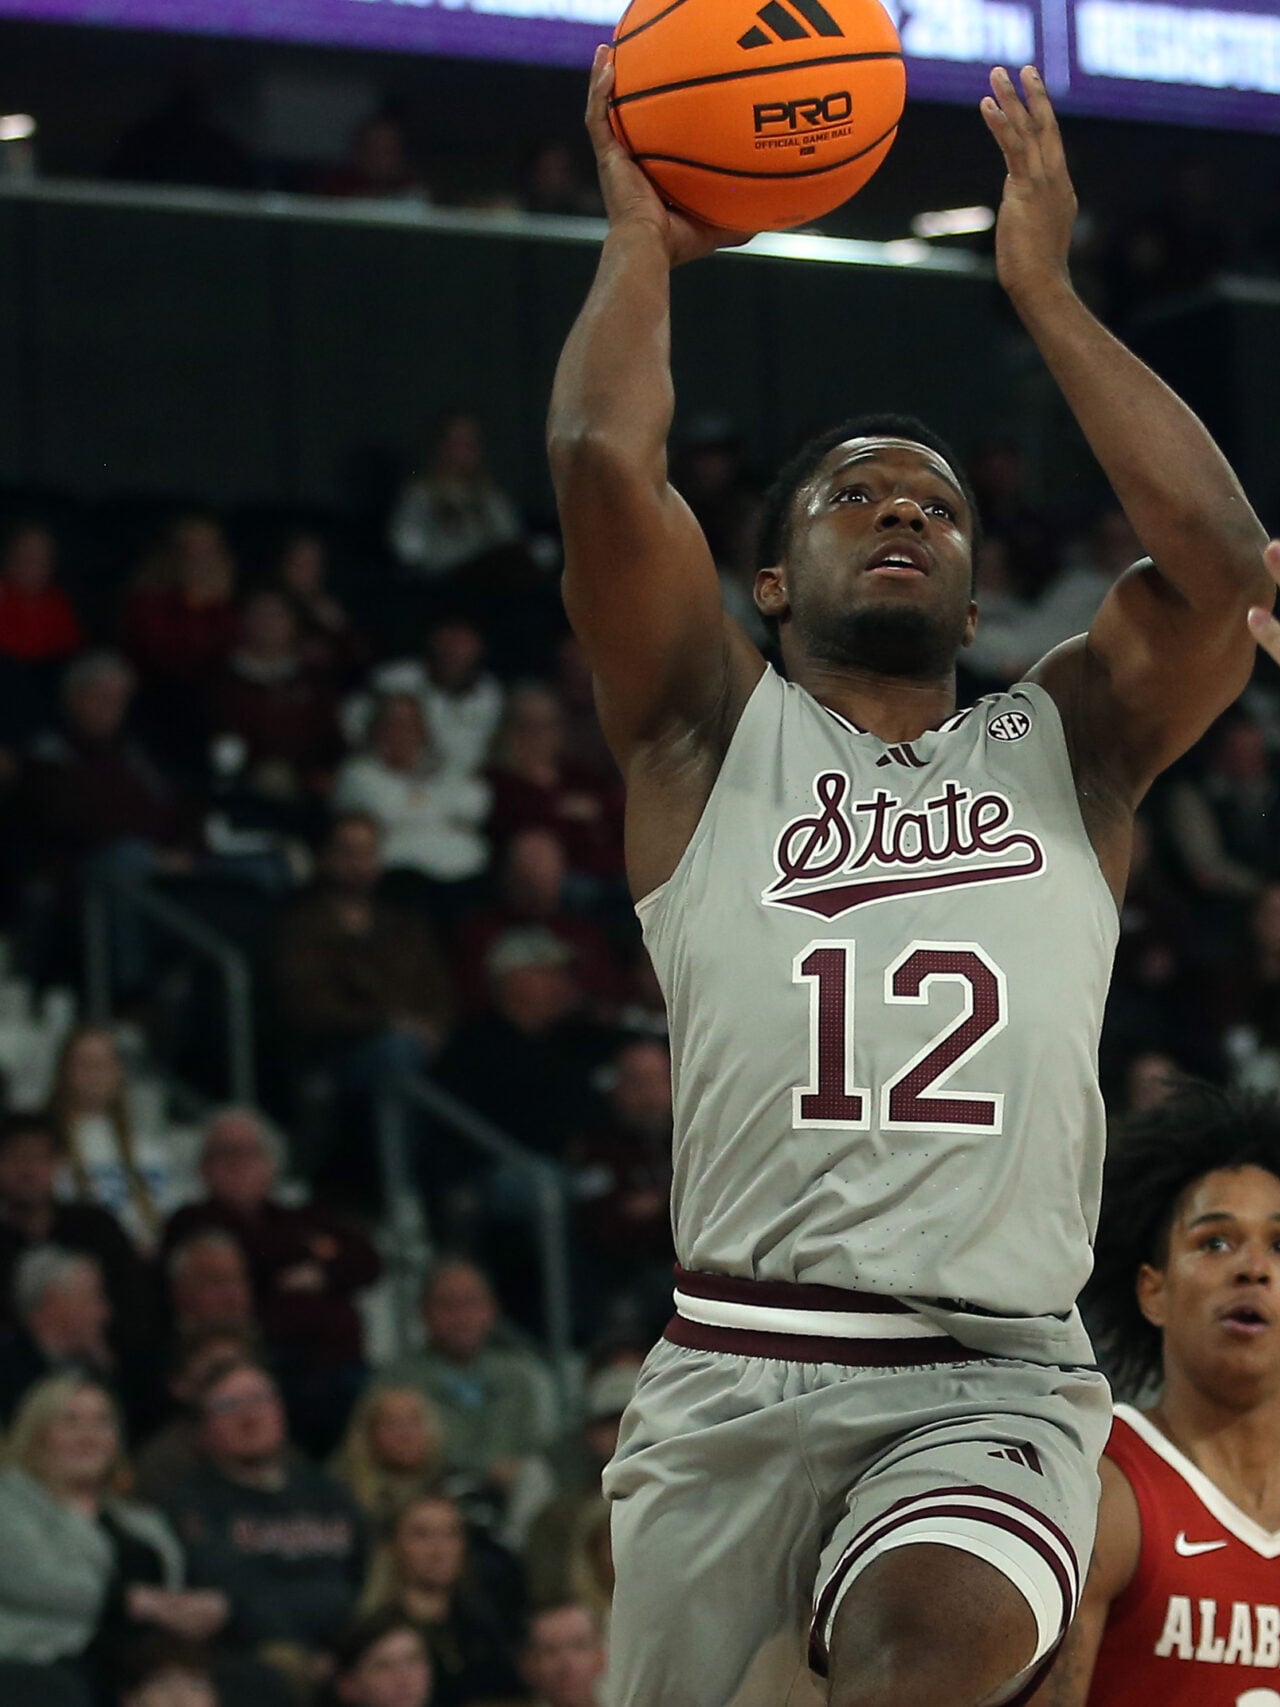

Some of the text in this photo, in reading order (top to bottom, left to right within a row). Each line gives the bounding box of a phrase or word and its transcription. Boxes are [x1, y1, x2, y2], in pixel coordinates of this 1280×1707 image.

[753, 91, 853, 132] PRO
[755, 127, 853, 149] OFFICIAL GAME BALL
[991, 713, 1028, 740] SEC
[761, 770, 1047, 922] State
[792, 938, 1009, 1135] 12
